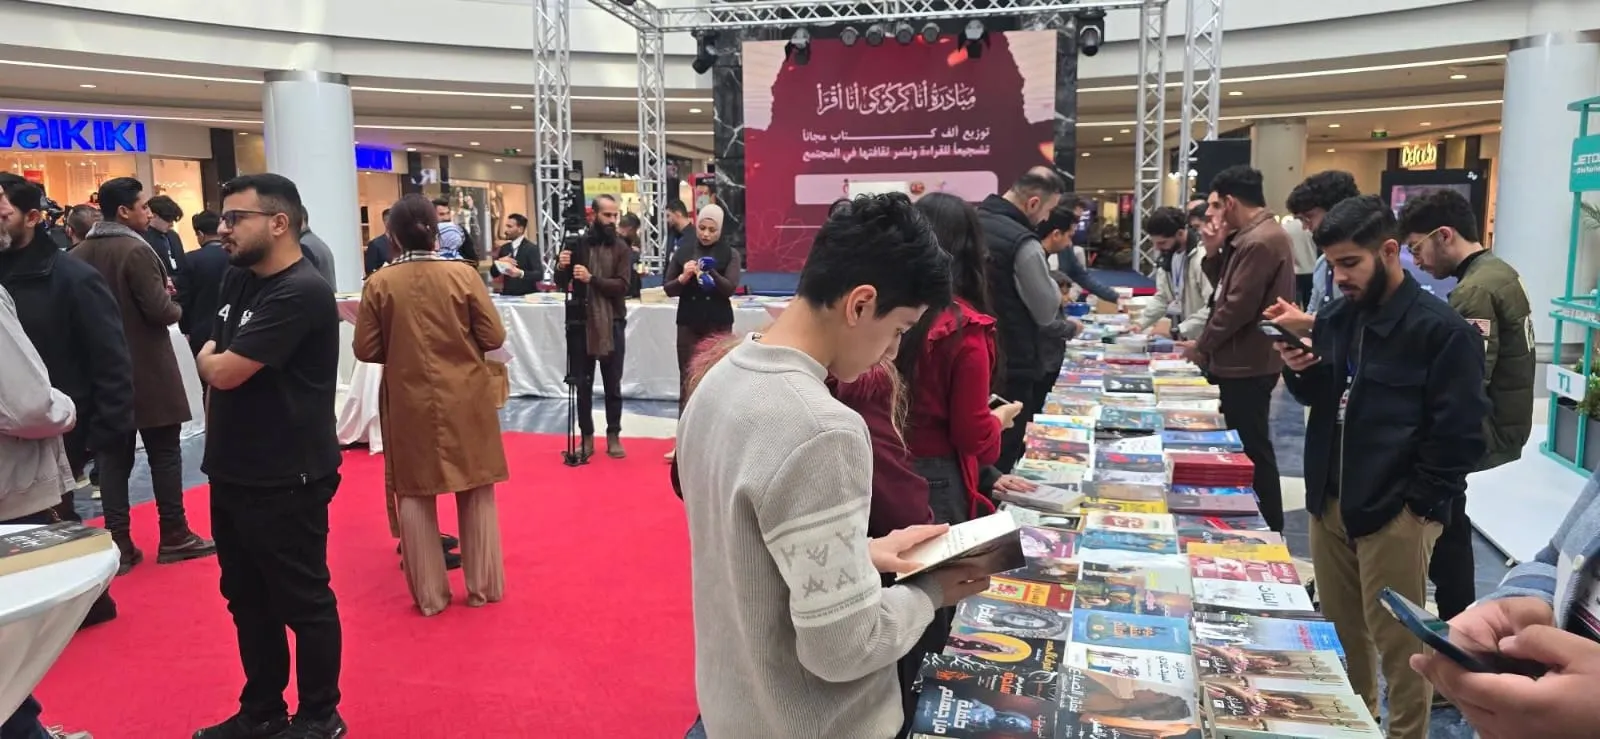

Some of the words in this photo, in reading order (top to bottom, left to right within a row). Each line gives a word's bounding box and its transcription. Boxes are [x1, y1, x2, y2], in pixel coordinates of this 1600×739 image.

[940, 125, 958, 138] ألف
[962, 127, 990, 141] توزيع
[802, 147, 840, 162] المجتمع
[842, 147, 857, 163] في
[893, 146, 918, 160] ونشر
[919, 144, 950, 159] للقراءة
[1558, 371, 1571, 395] T1
[937, 685, 956, 718] جهنم
[953, 699, 973, 729] طفلة
[931, 718, 951, 735] من
